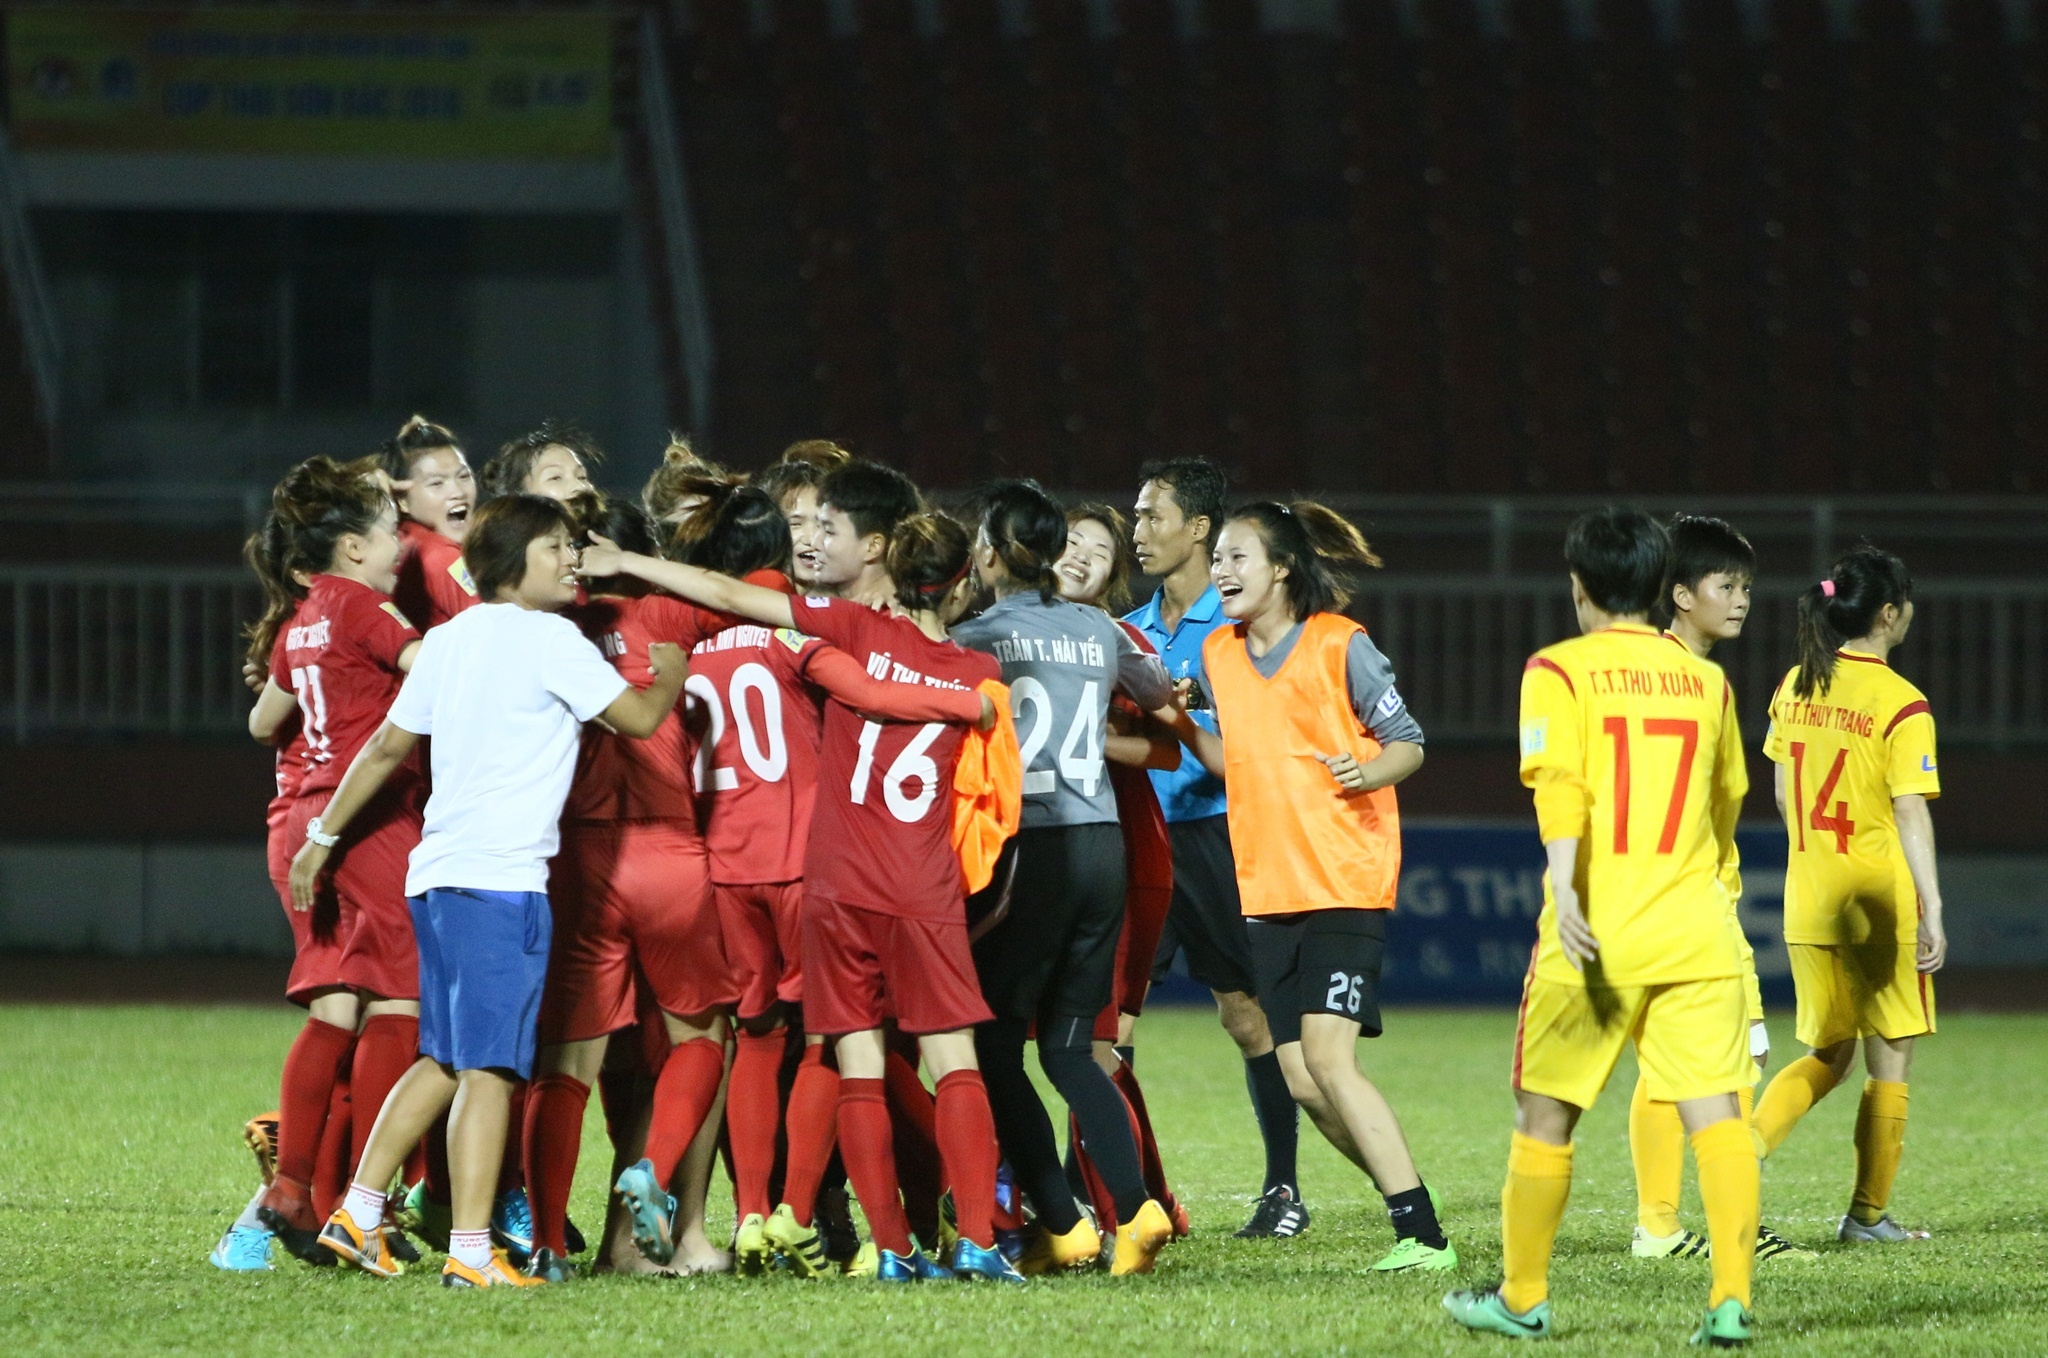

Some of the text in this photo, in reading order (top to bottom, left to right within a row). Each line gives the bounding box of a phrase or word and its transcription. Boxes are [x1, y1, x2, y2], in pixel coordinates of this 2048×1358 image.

[603, 631, 627, 657] NG
[992, 630, 1033, 663] TRẦN
[1034, 639, 1051, 662] T.
[1051, 634, 1077, 664] HẢI
[684, 662, 788, 793] 20
[1010, 676, 1103, 797] 24
[1834, 707, 1874, 738] TRANG
[850, 720, 938, 823] 16
[1603, 717, 1698, 855] 17
[1790, 741, 1854, 855] 14
[1393, 864, 1542, 918] G TH
[1325, 971, 1364, 1014] 26
